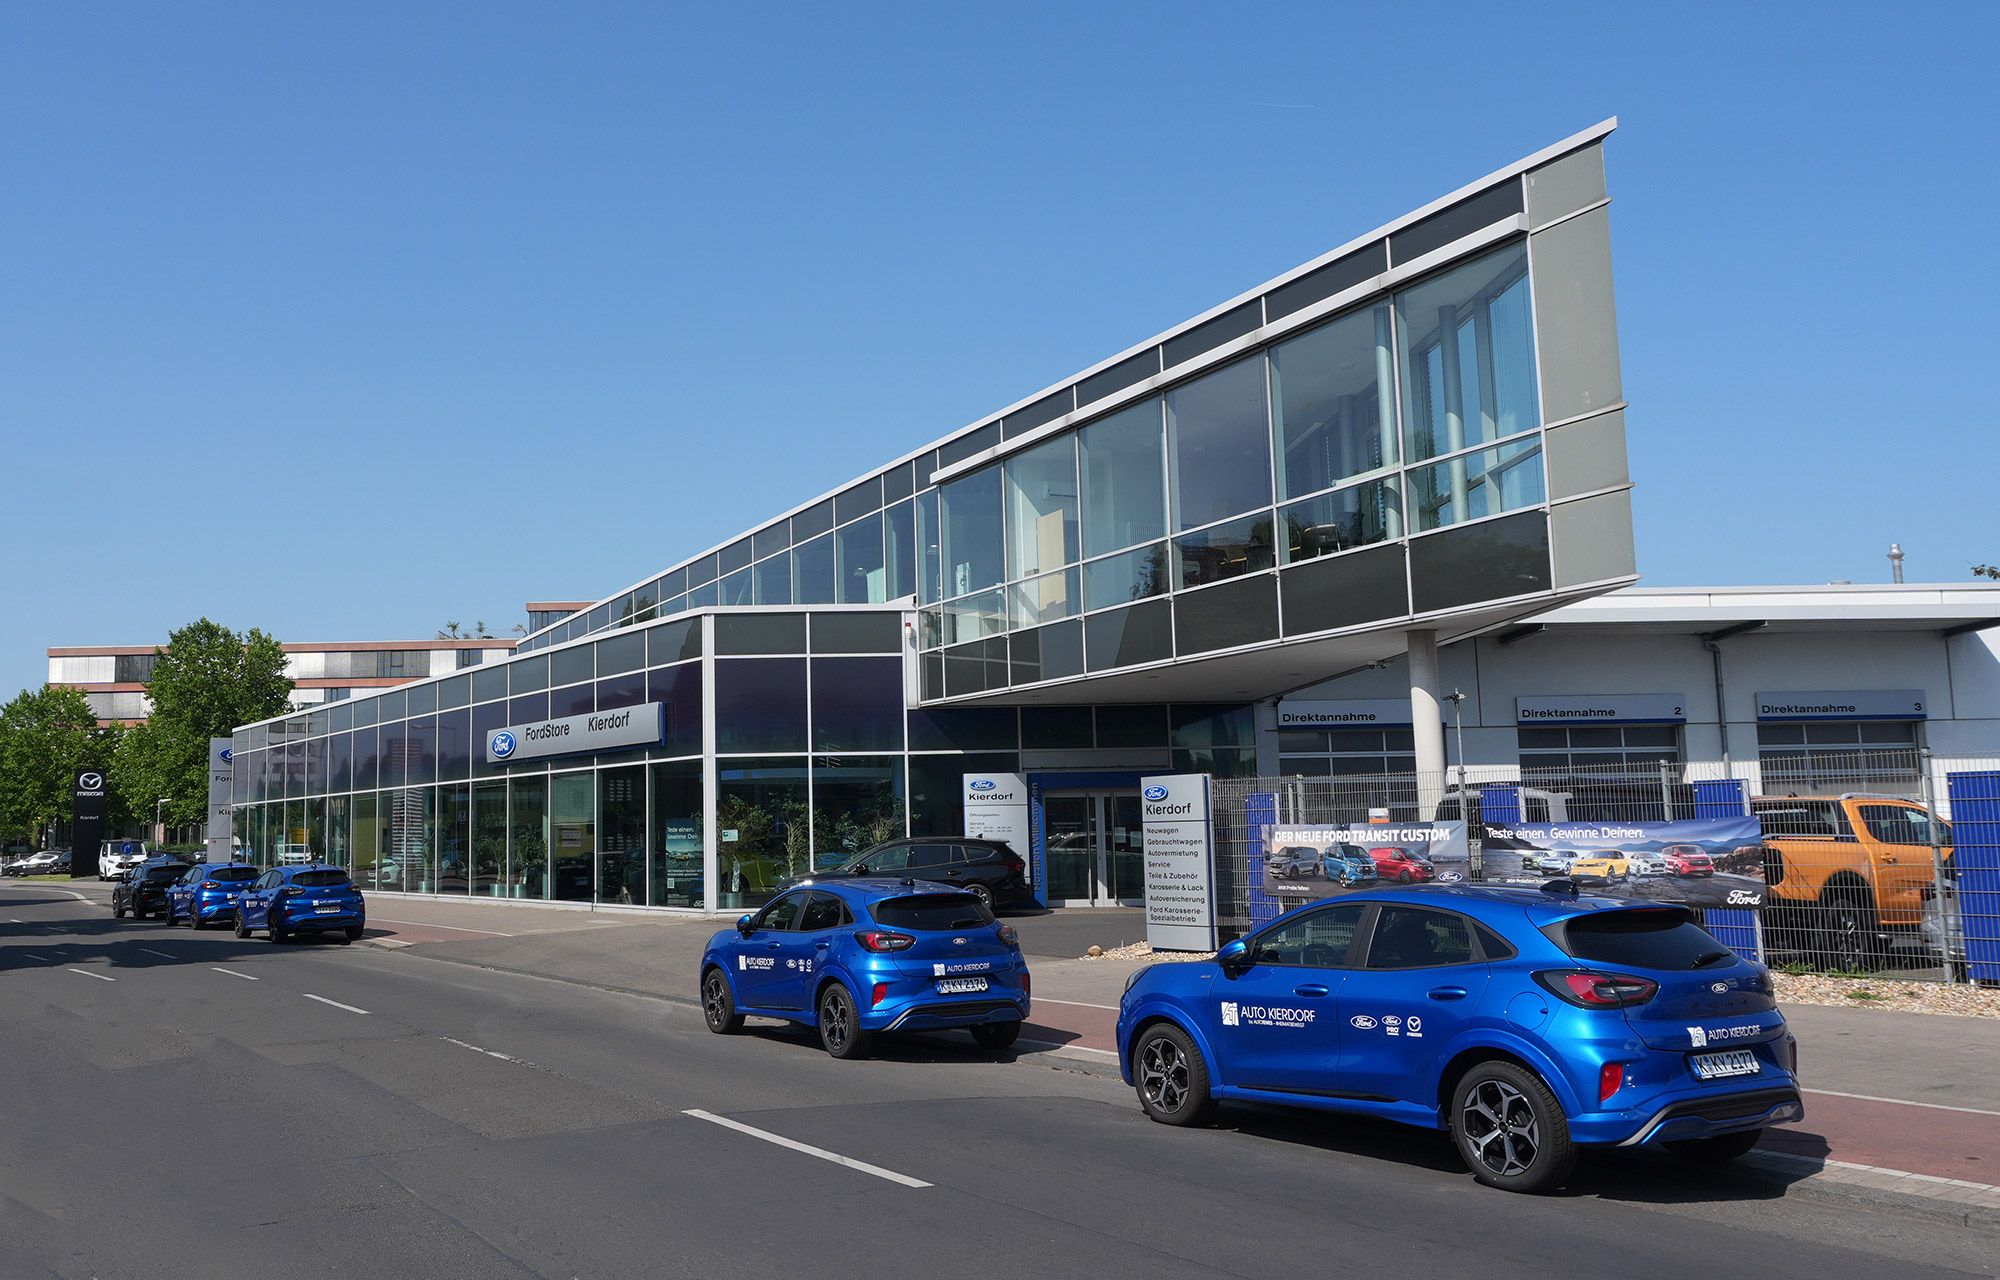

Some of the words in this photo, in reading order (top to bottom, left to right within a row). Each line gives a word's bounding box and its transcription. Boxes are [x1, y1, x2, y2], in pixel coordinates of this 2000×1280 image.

[1521, 708, 1616, 718] Direktannahme
[1673, 707, 1682, 716] 2
[1762, 704, 1856, 714] Direktannahme
[1913, 702, 1922, 712] 3
[1282, 712, 1377, 723] Direktannahme
[525, 722, 570, 741] FordStore
[588, 711, 630, 732] Kierdorf
[969, 792, 1013, 801] Kierdorf
[1145, 803, 1191, 815] Kierdorf
[1031, 783, 1041, 847] Willkommen
[1274, 830, 1294, 843] DER
[1294, 830, 1321, 843] NEUE
[1322, 830, 1350, 843] FORD
[1351, 829, 1400, 842] TRANSIT
[1400, 828, 1451, 842] CUSTOM
[1485, 827, 1514, 840] Teste
[1515, 827, 1548, 840] einen.
[1550, 826, 1600, 840] Gewinne
[1601, 826, 1646, 839] Deinen.
[1147, 838, 1203, 846] Gebrauchtwagen
[1148, 850, 1199, 858] Autovermietung
[1169, 872, 1198, 880] Zubehör
[1149, 883, 1180, 891] Karosserie
[1187, 884, 1205, 892] Lack
[1150, 895, 1206, 904] Autoversicherung
[1727, 889, 1762, 905] Ford
[1164, 906, 1204, 915] Karosserie-
[1150, 914, 1197, 922] Spezialbetrieb
[947, 964, 963, 973] AUTO
[963, 962, 990, 972] KIERDORF
[940, 980, 947, 991] K
[1241, 1006, 1266, 1019] AUTO
[1267, 1007, 1315, 1022] KIERDORF
[1708, 1029, 1730, 1040] AUTO
[1729, 1025, 1761, 1039] KIERDORF
[1695, 1056, 1709, 1074] K
[1709, 1055, 1727, 1072] KY
[1727, 1052, 1755, 1070] 2177
